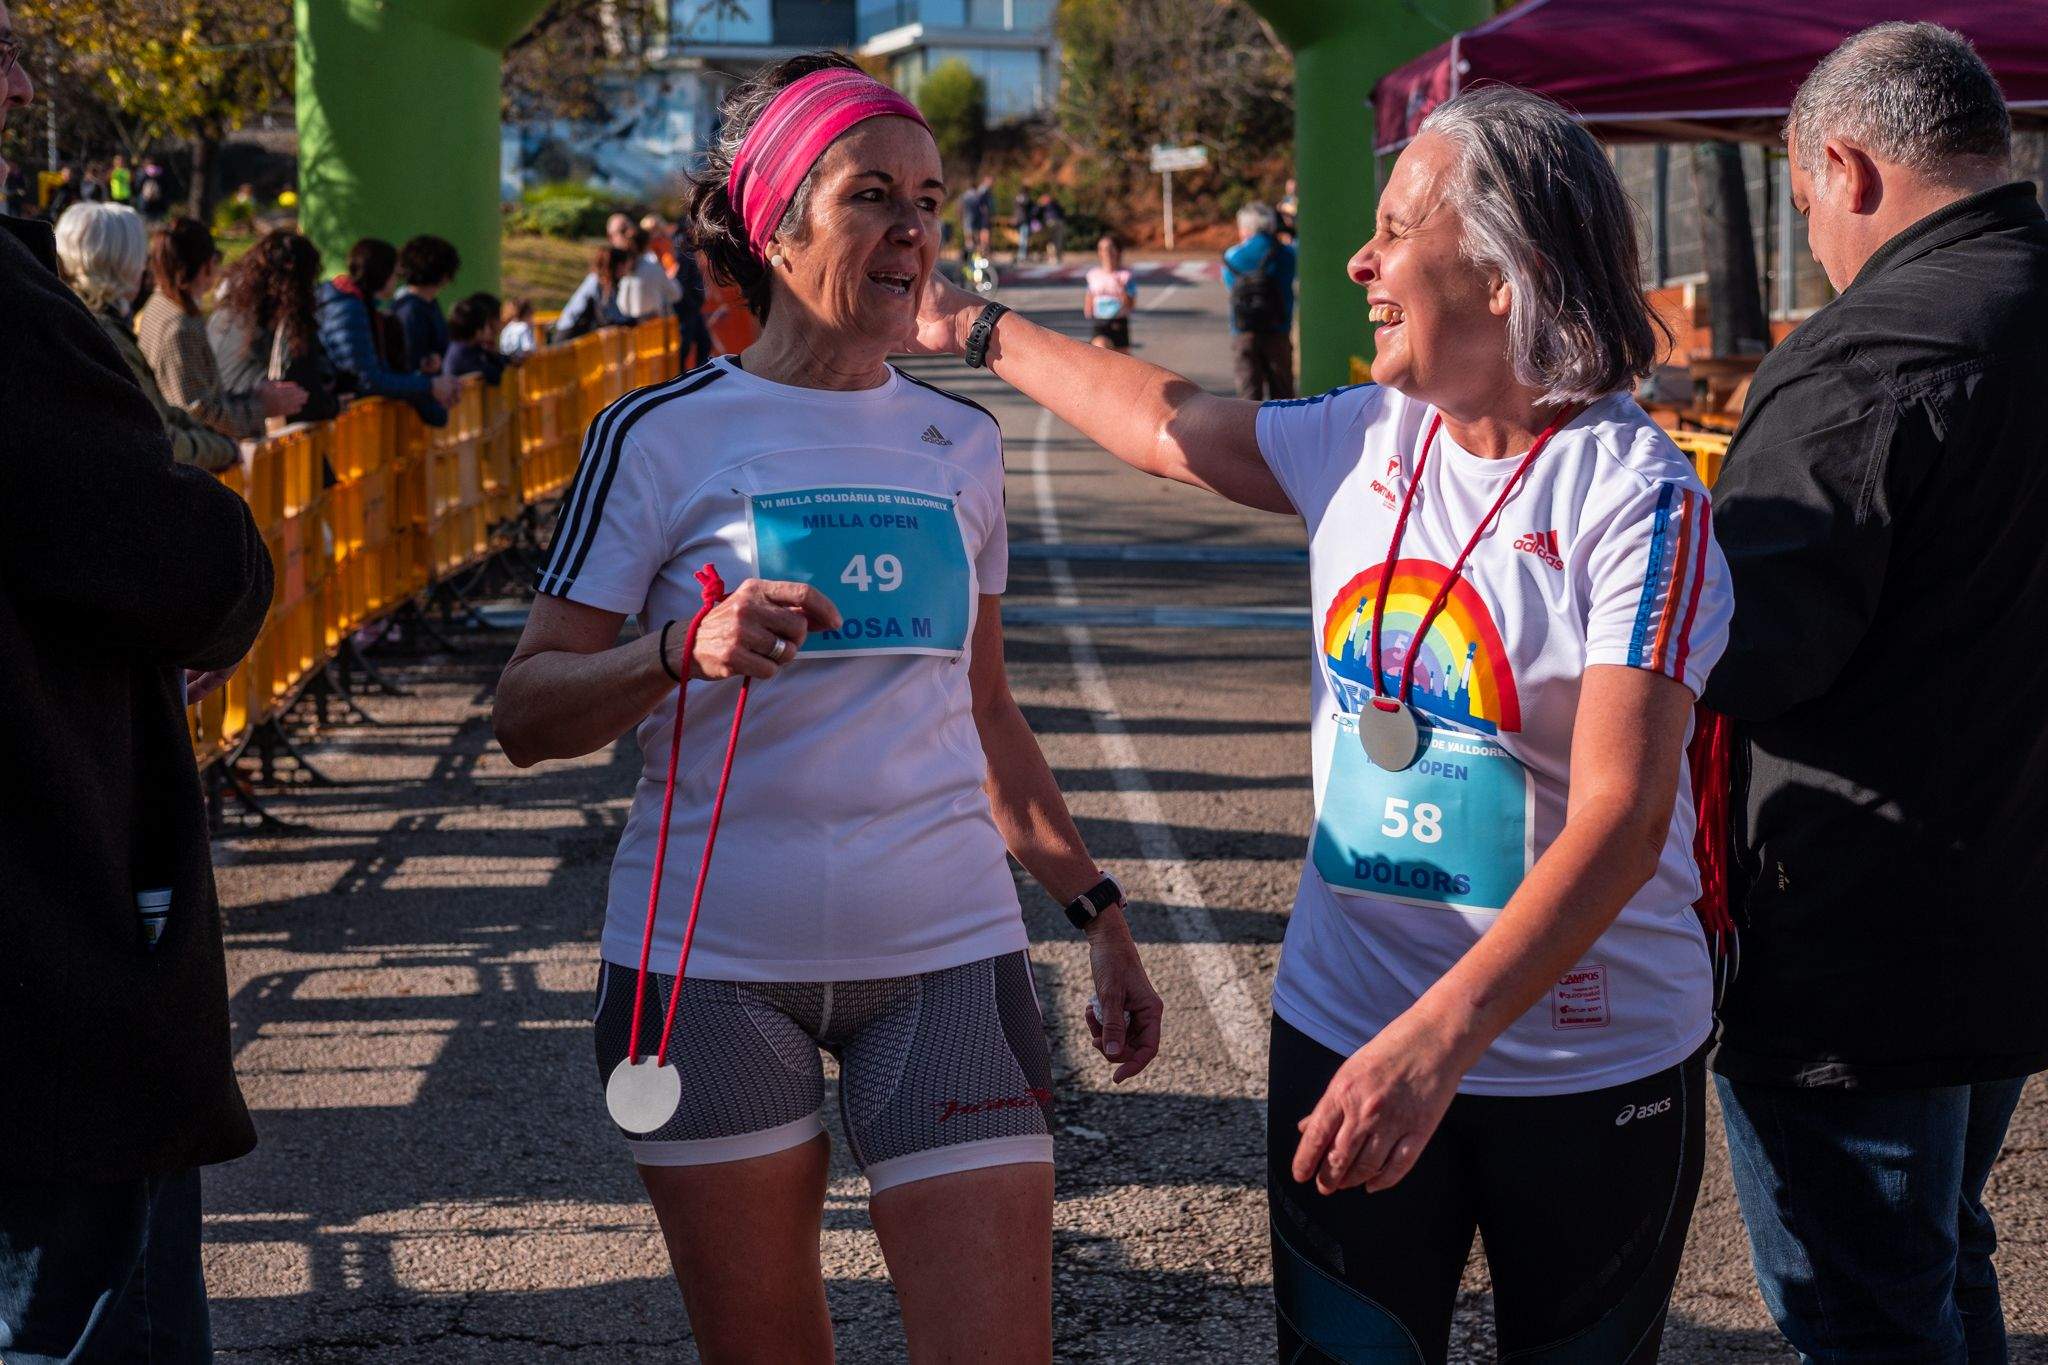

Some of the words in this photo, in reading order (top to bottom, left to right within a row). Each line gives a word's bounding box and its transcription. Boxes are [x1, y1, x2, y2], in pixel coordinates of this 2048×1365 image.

[760, 500, 773, 509] VI
[776, 495, 812, 508] MILLA
[877, 494, 892, 503] DE
[893, 495, 948, 511] VALLDOREIX
[802, 513, 864, 530] MILLA
[870, 513, 919, 530] OPEN
[1513, 537, 1566, 572] adidas
[840, 553, 903, 592] 49
[912, 617, 933, 639] M
[1432, 739, 1445, 749] DE
[1448, 741, 1512, 761] VALLDORE
[1418, 760, 1468, 781] OPEN
[1381, 796, 1442, 843] 58
[1354, 857, 1471, 895] DOLORS
[1636, 1097, 1671, 1119] asics
